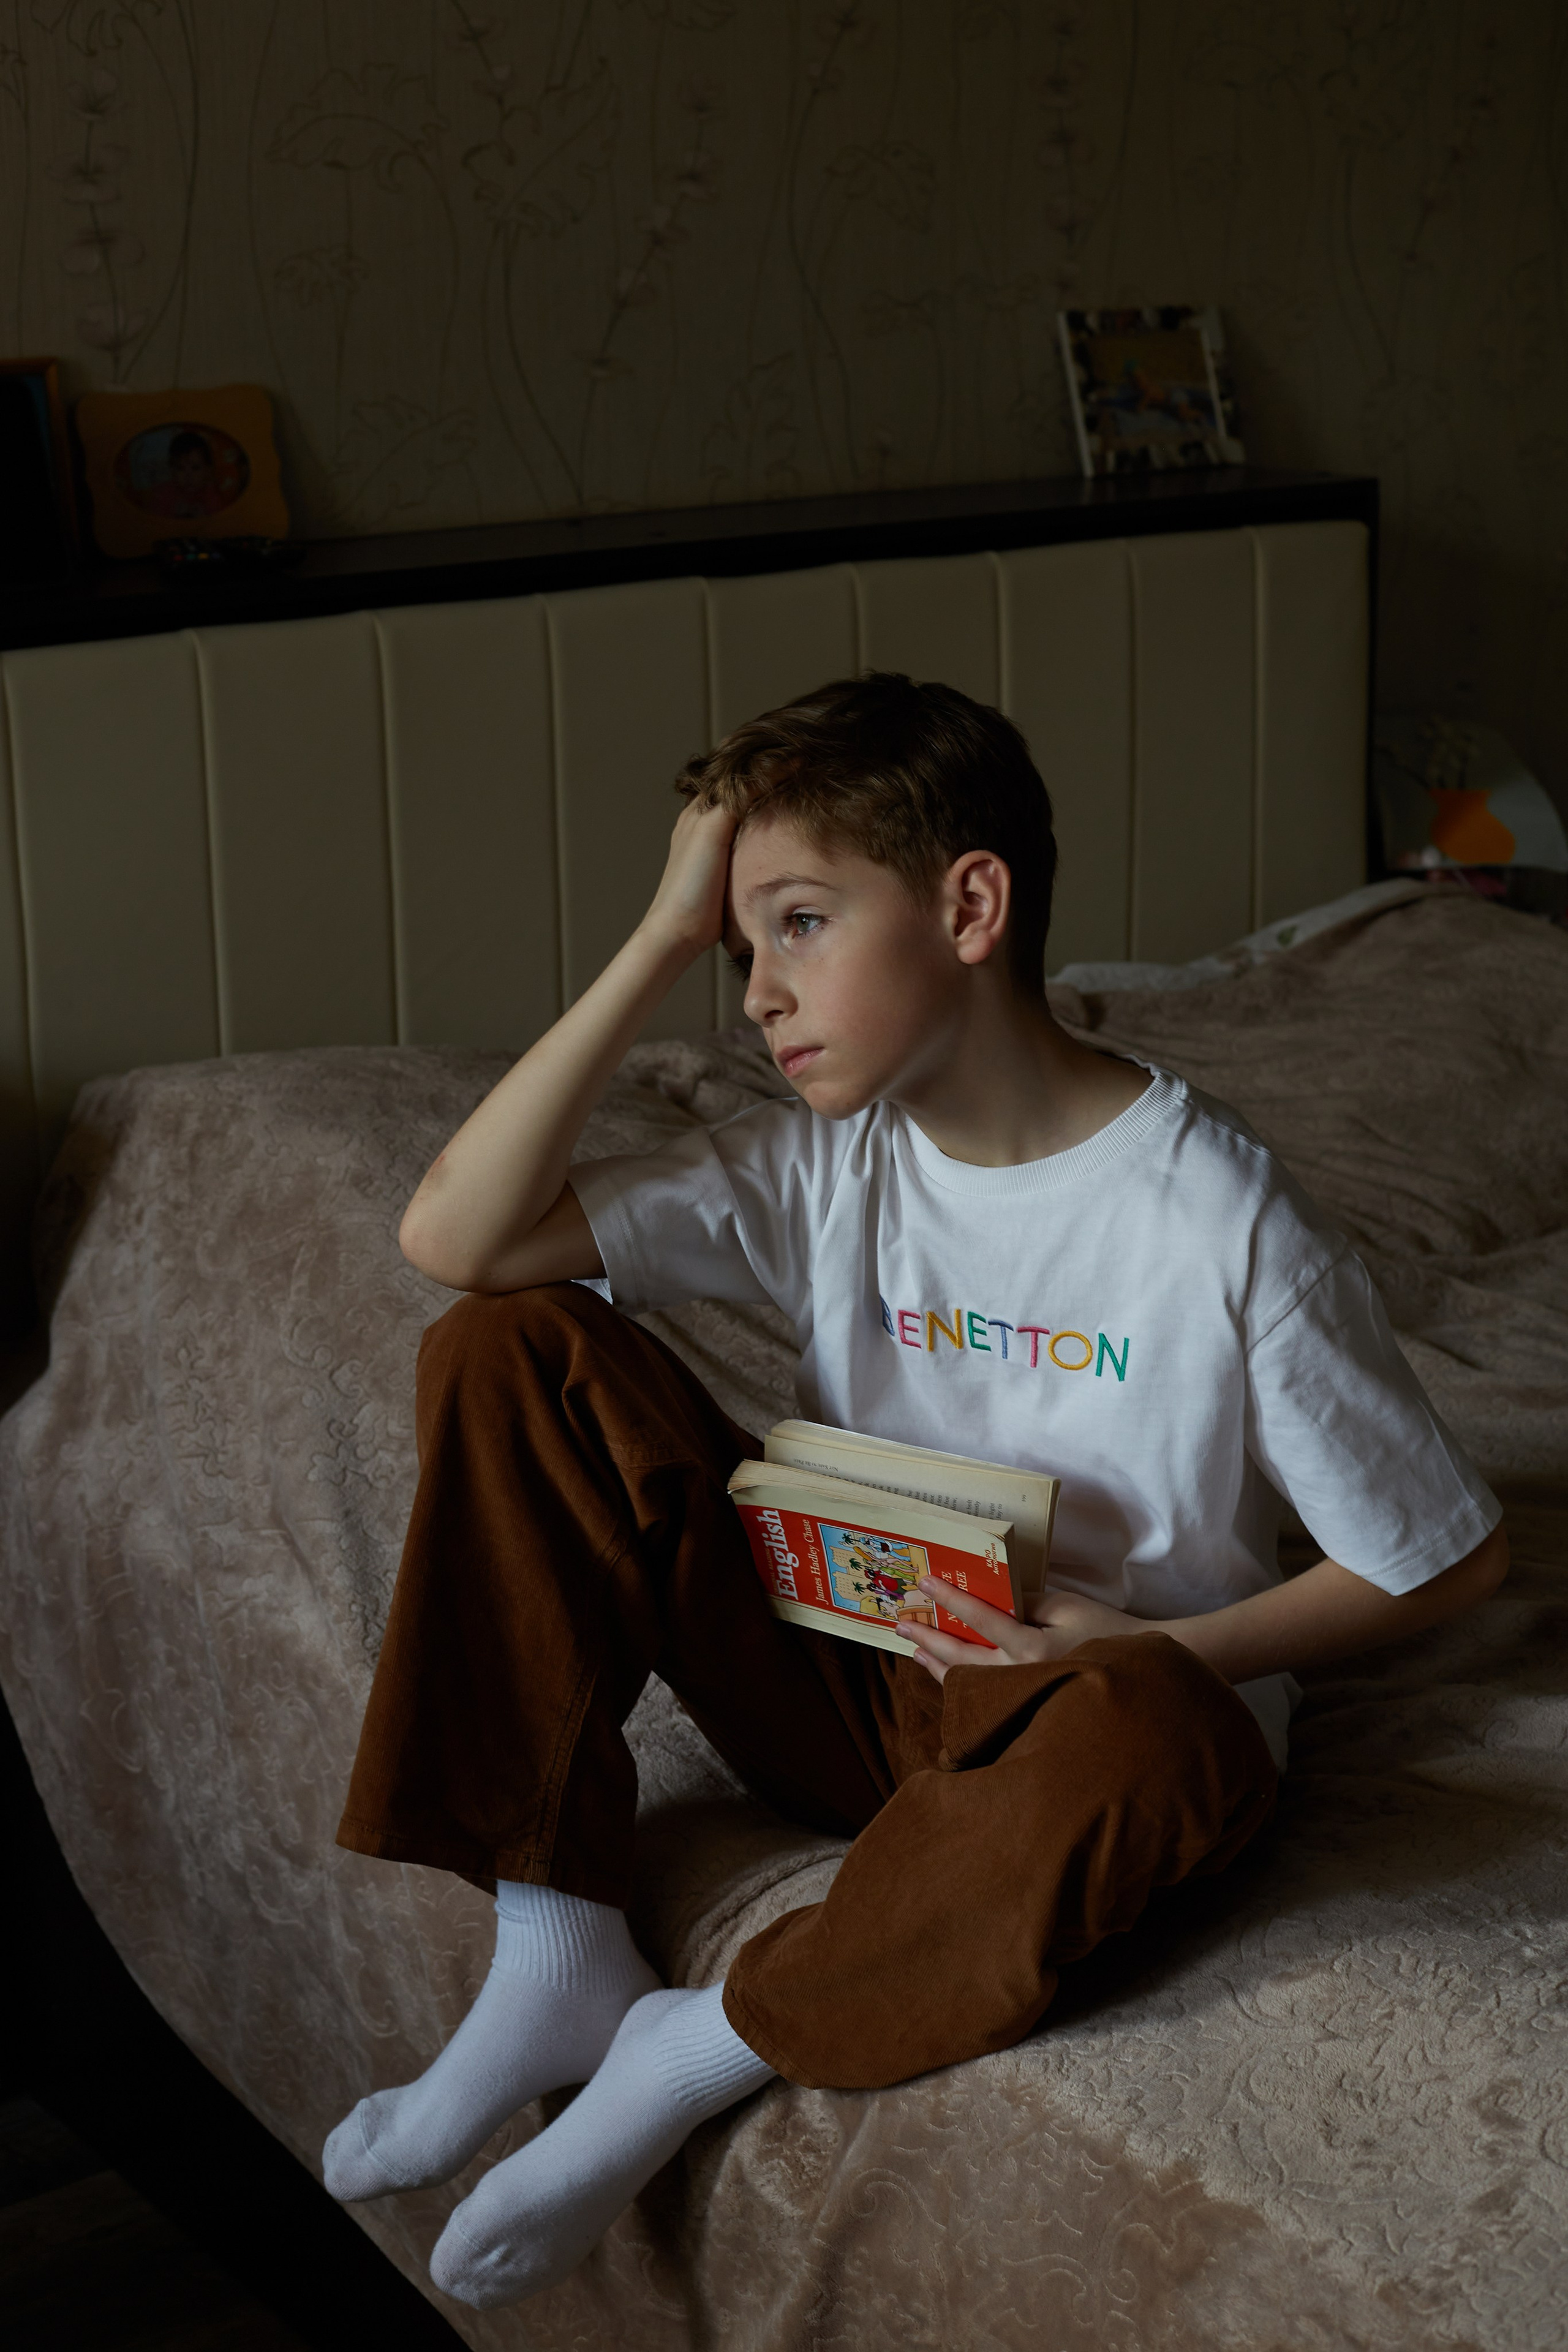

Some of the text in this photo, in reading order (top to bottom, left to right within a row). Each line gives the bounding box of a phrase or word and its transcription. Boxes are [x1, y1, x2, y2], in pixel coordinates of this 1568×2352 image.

[879, 1294, 1129, 1382] BENETTON
[755, 1509, 800, 1600] English
[802, 1519, 829, 1605] James Hadley Chase
[956, 1570, 968, 1592] REE
[984, 1550, 993, 1568] КАРО
[991, 1543, 1000, 1575] Антология
